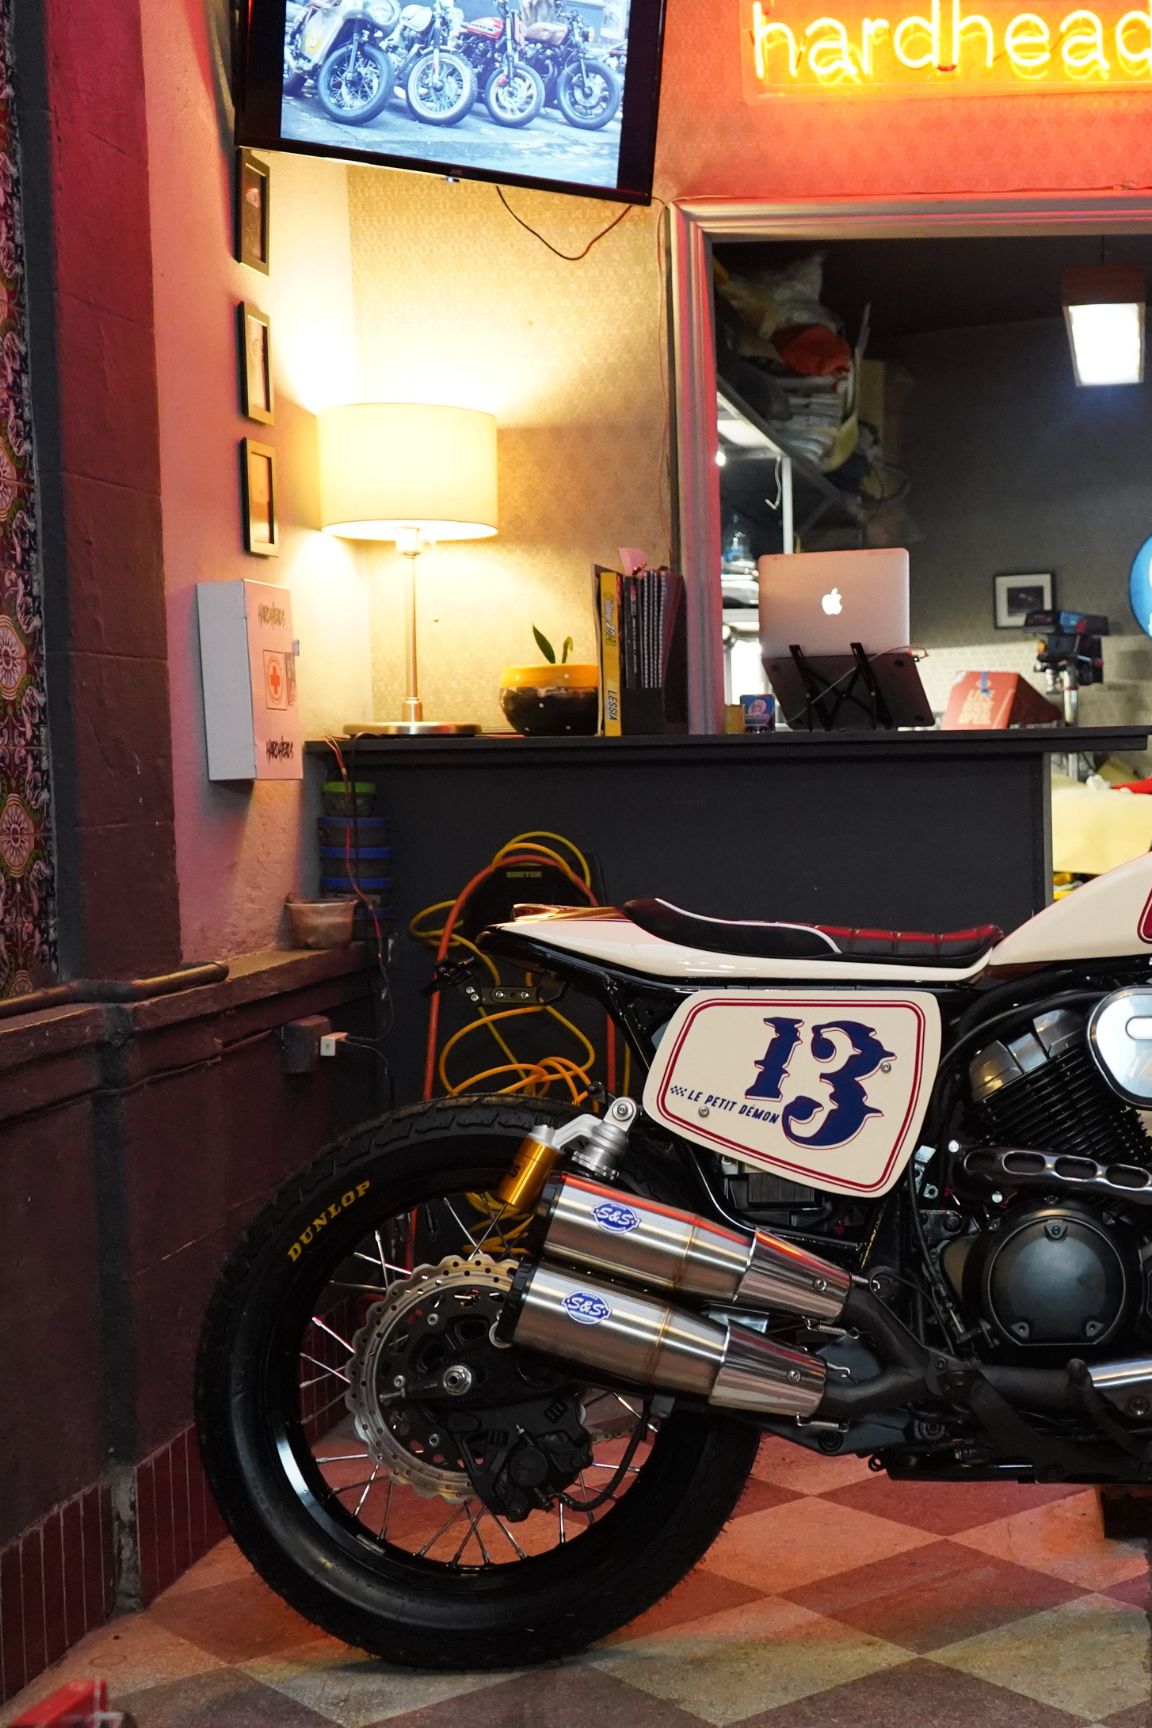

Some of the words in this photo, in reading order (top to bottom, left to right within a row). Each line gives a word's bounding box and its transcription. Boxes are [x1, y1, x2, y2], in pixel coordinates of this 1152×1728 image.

[744, 1016, 897, 1150] 13
[687, 1089, 703, 1102] LE
[704, 1094, 737, 1112] PETIT
[738, 1103, 780, 1124] DÉMON
[287, 1180, 371, 1262] DUNLOP
[597, 1207, 634, 1225] S&S
[568, 1297, 605, 1316] S&S
